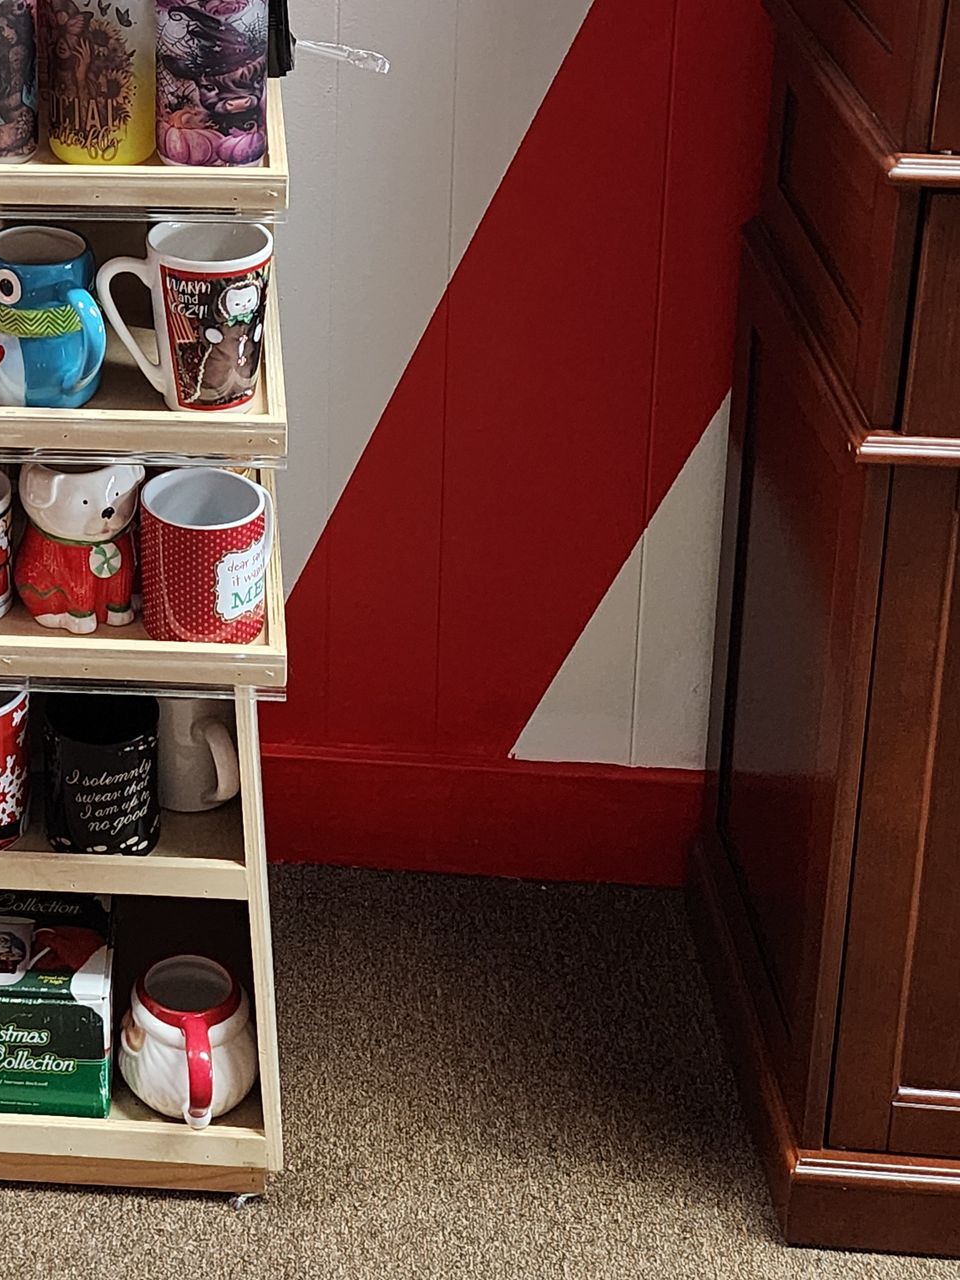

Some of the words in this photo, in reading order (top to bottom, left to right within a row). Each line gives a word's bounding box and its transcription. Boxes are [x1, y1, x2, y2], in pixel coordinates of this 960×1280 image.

[166, 276, 212, 294] WARM
[178, 293, 199, 304] and
[171, 302, 209, 319] COZY!
[227, 559, 250, 573] dear
[232, 574, 241, 587] it
[65, 769, 80, 784] I
[82, 758, 152, 787] solemnly
[75, 789, 122, 803] swear
[123, 775, 150, 797] that
[80, 804, 93, 820] I
[95, 805, 119, 817] am
[121, 794, 139, 813] up
[88, 820, 111, 832] no
[110, 796, 151, 836] good
